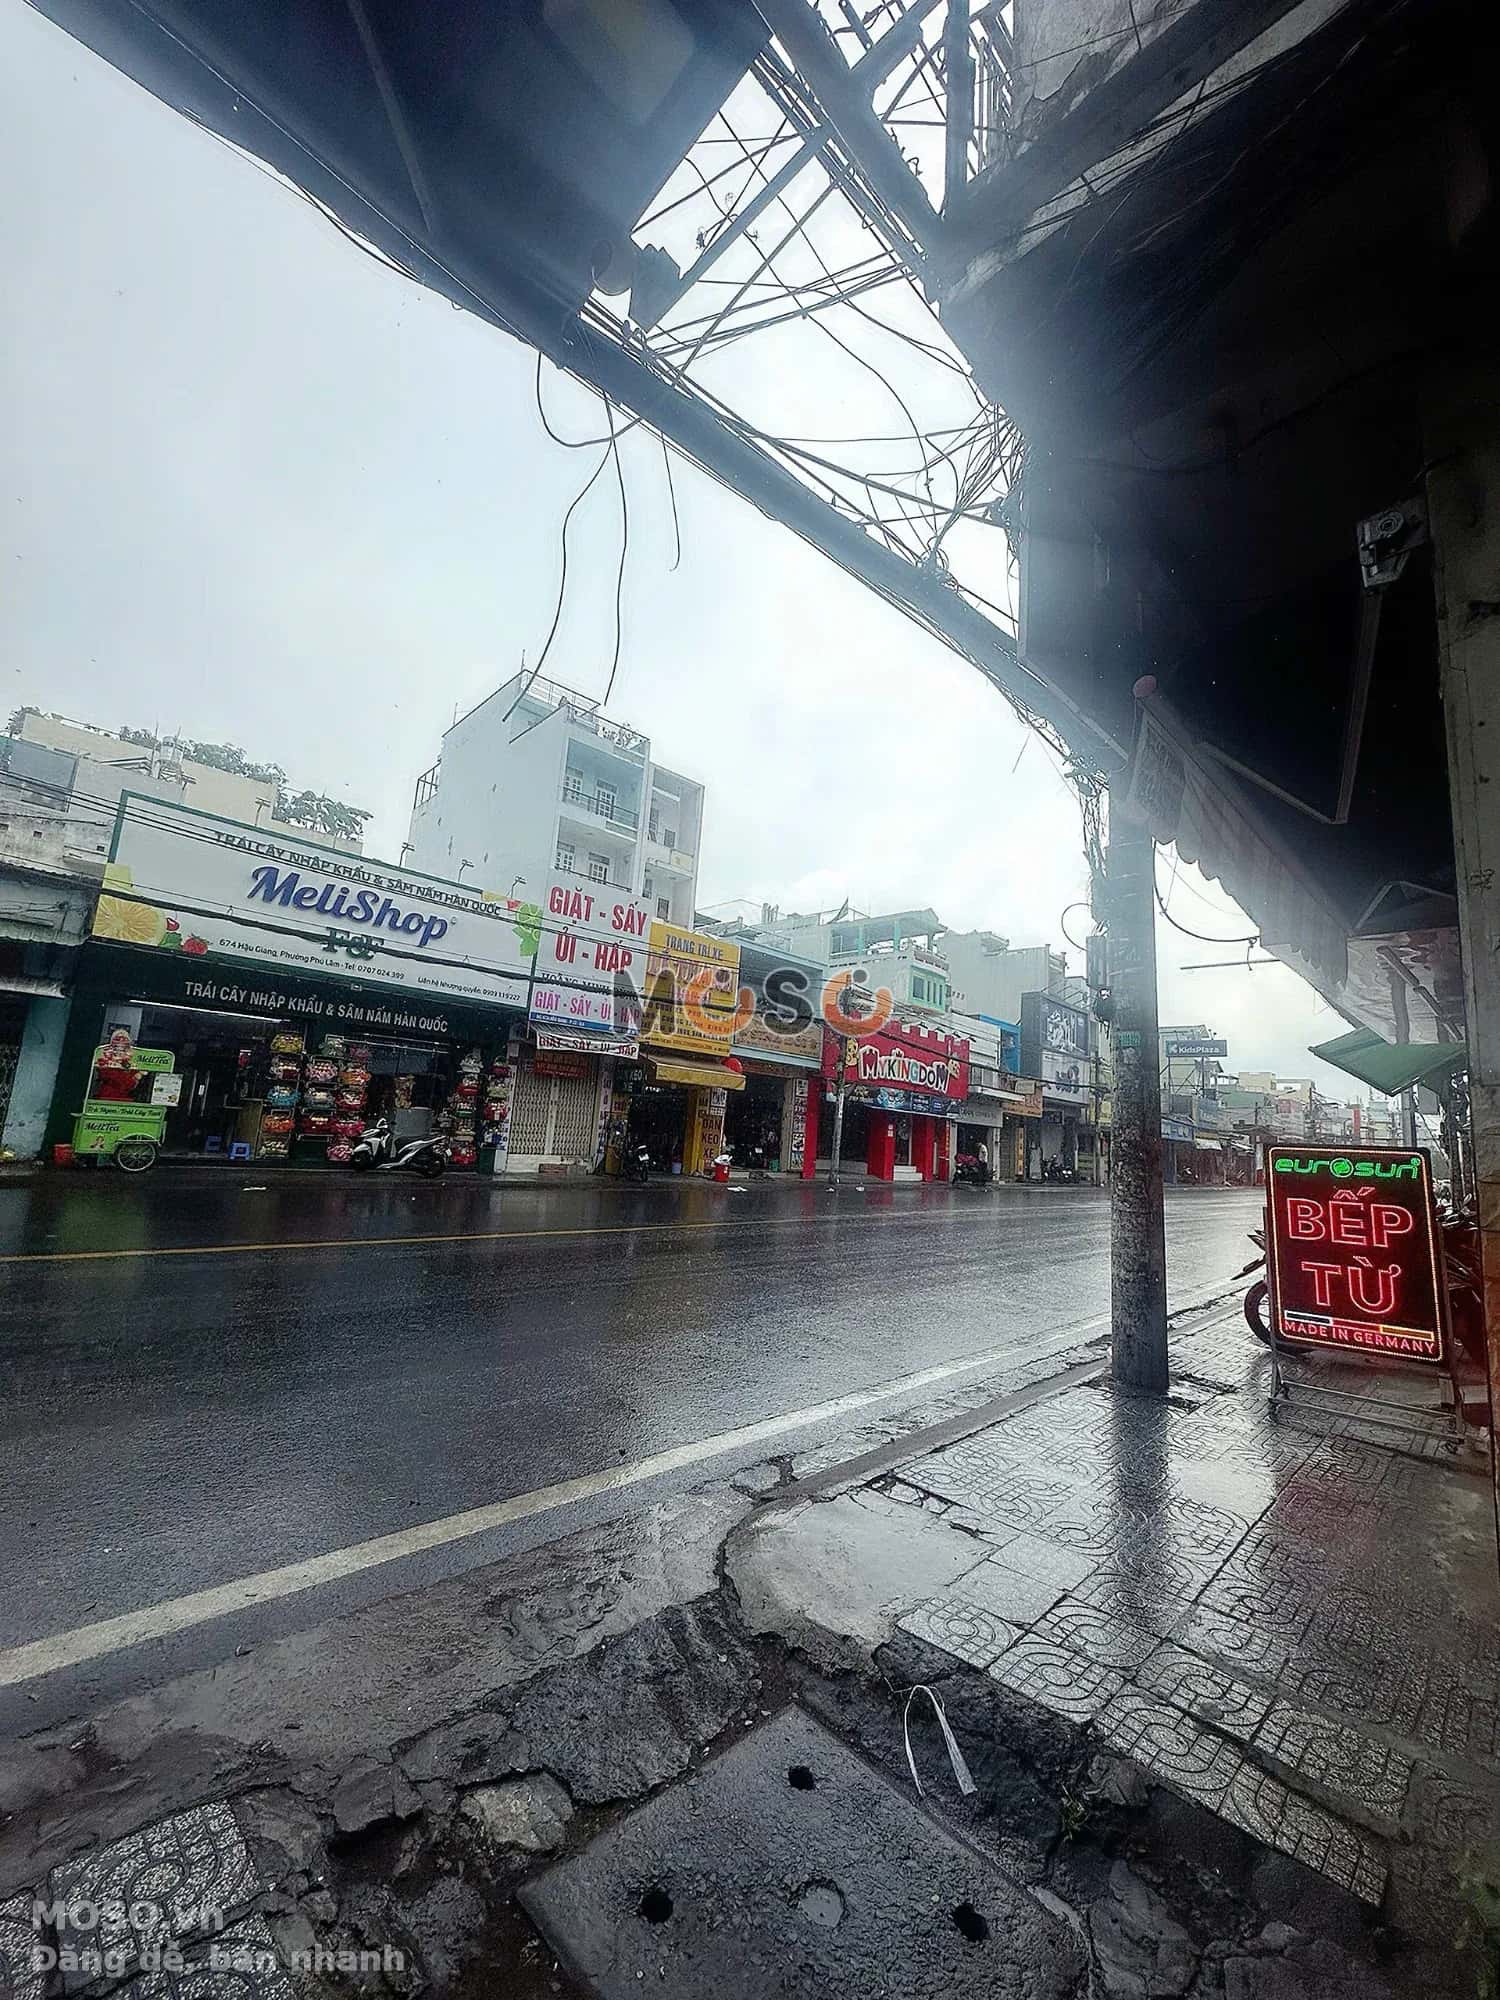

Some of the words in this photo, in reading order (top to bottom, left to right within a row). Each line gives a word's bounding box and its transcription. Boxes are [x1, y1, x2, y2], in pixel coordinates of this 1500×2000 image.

[374, 874, 384, 885] &
[247, 866, 448, 947] MeliShop
[549, 886, 595, 925] GIẶT
[612, 901, 648, 937] SẤY
[219, 938, 236, 949] 674
[237, 941, 254, 953] Hậu
[555, 926, 577, 964] ỦI
[594, 940, 634, 975] HẤP
[665, 934, 695, 954] TRANG
[184, 980, 217, 999] TRÁI
[220, 985, 248, 1004] CÂY
[249, 991, 286, 1010] NHẬP
[288, 994, 324, 1015] KHẨU
[325, 1003, 334, 1016] &
[337, 1002, 364, 1020] SÂM
[366, 1005, 392, 1025] NẤM
[394, 1010, 417, 1028] HÀN
[419, 1014, 448, 1033] QUỐC
[534, 988, 561, 1014] GIẶT
[570, 993, 592, 1017] SẤY
[859, 1045, 950, 1095] MYKINGDOM
[1178, 1045, 1221, 1054] KidsPlaza
[1274, 1157, 1421, 1179] eurosun
[1286, 1186, 1413, 1248] BẾP
[1301, 1255, 1401, 1314] TỪ
[1284, 1321, 1328, 1338] MADE
[1331, 1327, 1350, 1341] IN
[1353, 1331, 1435, 1355] GERMANY
